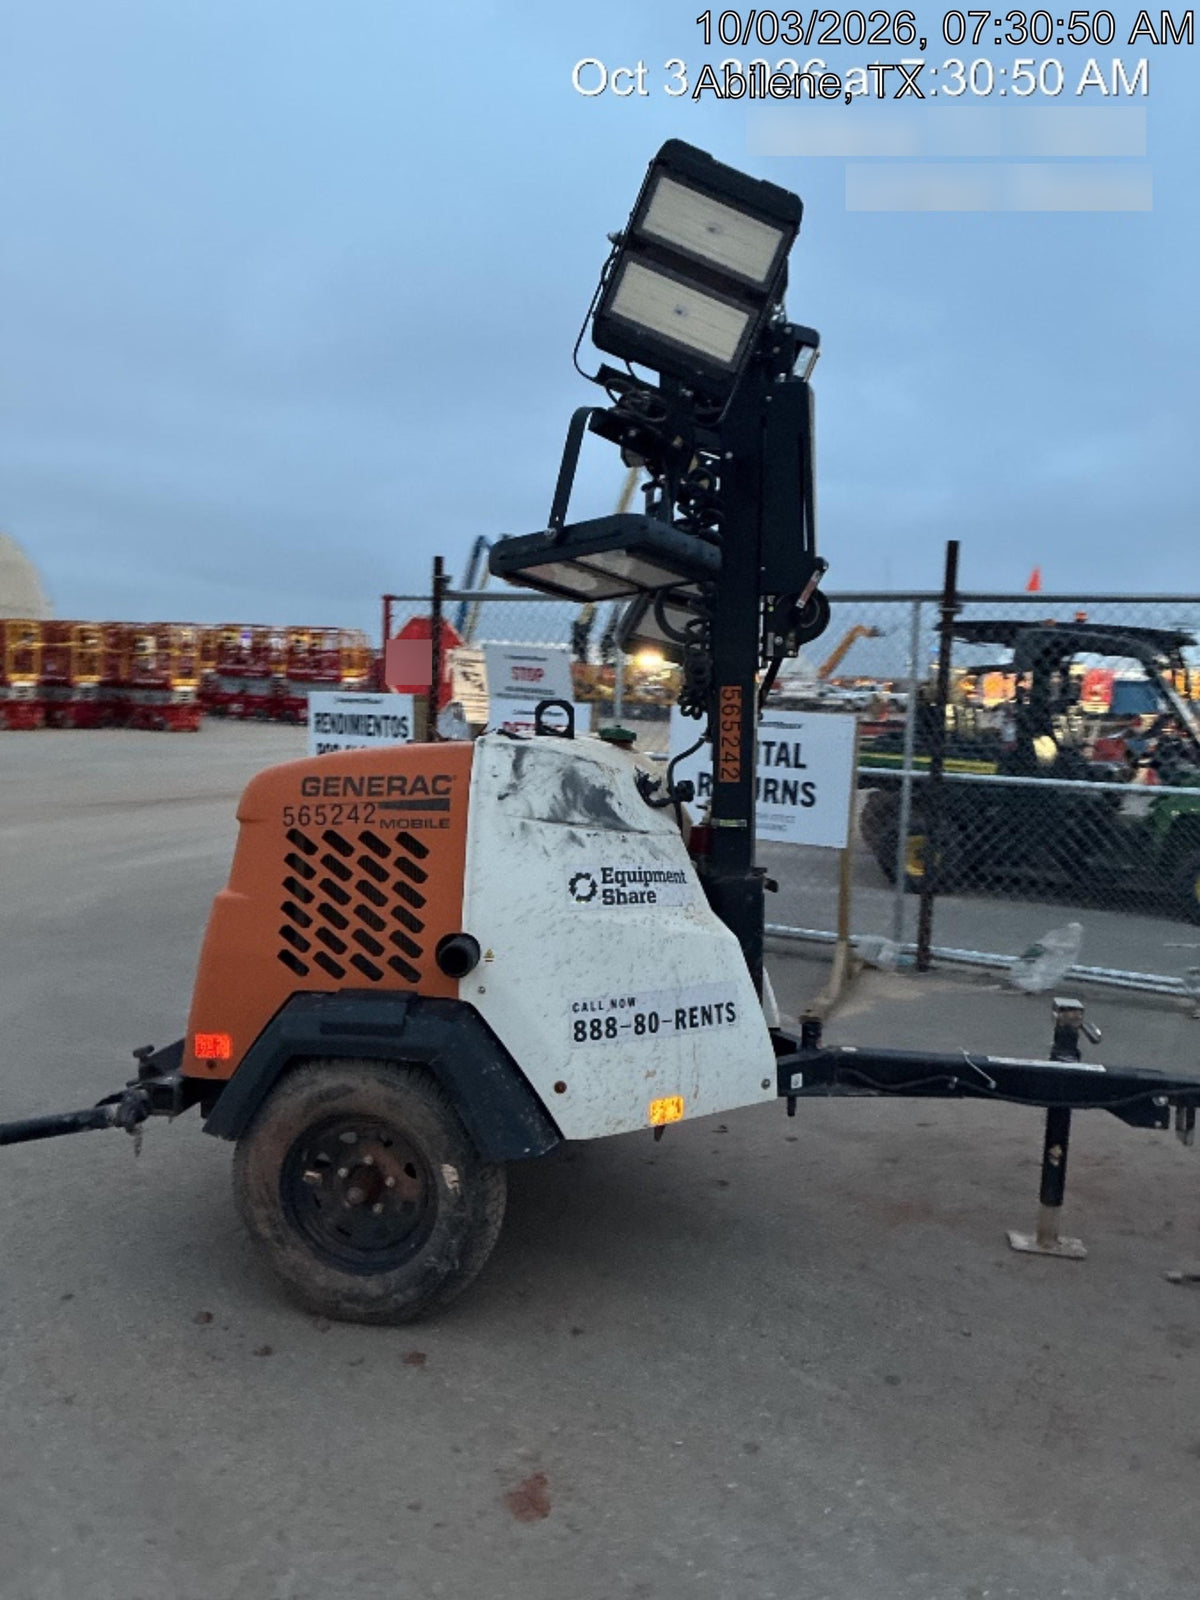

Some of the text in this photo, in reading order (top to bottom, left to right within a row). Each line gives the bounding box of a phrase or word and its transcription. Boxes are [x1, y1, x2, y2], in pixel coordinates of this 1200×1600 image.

[511, 666, 545, 682] STOP
[719, 687, 741, 781] 565242
[301, 774, 452, 797] GENERAC
[283, 802, 377, 827] 565242
[379, 817, 450, 829] MOBILE
[600, 866, 688, 887] Equipment
[602, 888, 658, 906] Share
[571, 997, 637, 1013] CALL NOW
[573, 1001, 738, 1043] 888-80-RENTS
